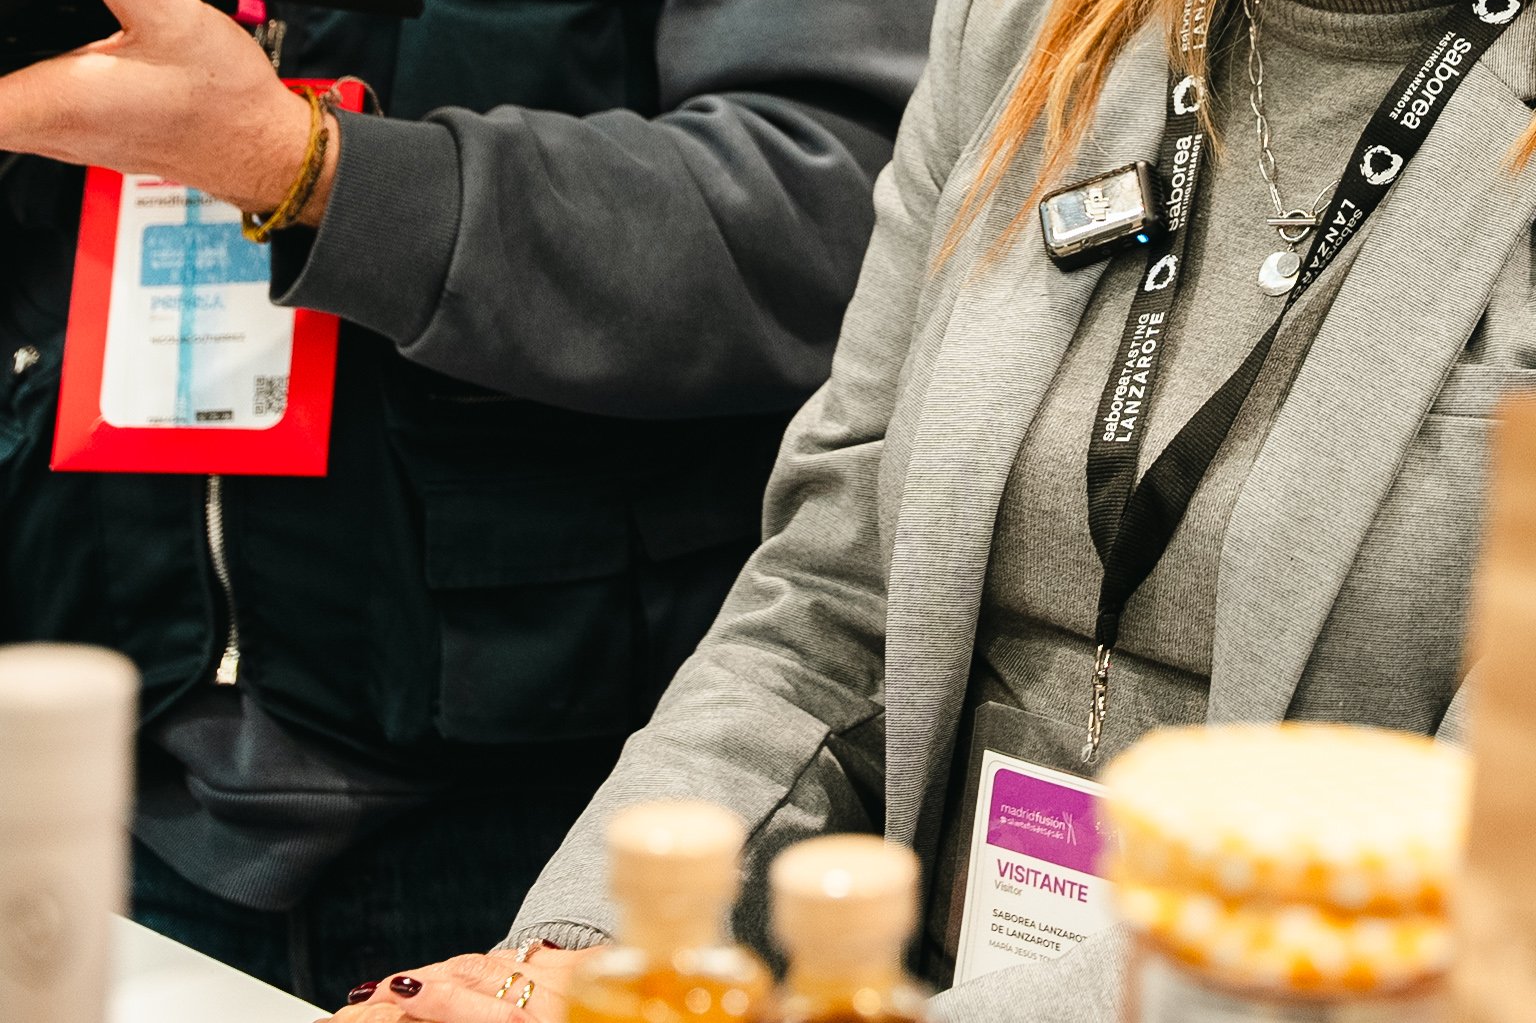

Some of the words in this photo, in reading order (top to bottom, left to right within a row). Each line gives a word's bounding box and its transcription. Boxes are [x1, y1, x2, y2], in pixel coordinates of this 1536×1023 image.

[1400, 37, 1472, 130] saborea
[1165, 134, 1193, 233] saborea
[1114, 311, 1166, 442] LANZAROTE
[994, 879, 1023, 897] Visitor
[996, 858, 1089, 904] VISITANTE
[990, 923, 1004, 934] DE
[1005, 927, 1062, 952] LANZAROTE
[992, 908, 1036, 929] SABOREA
